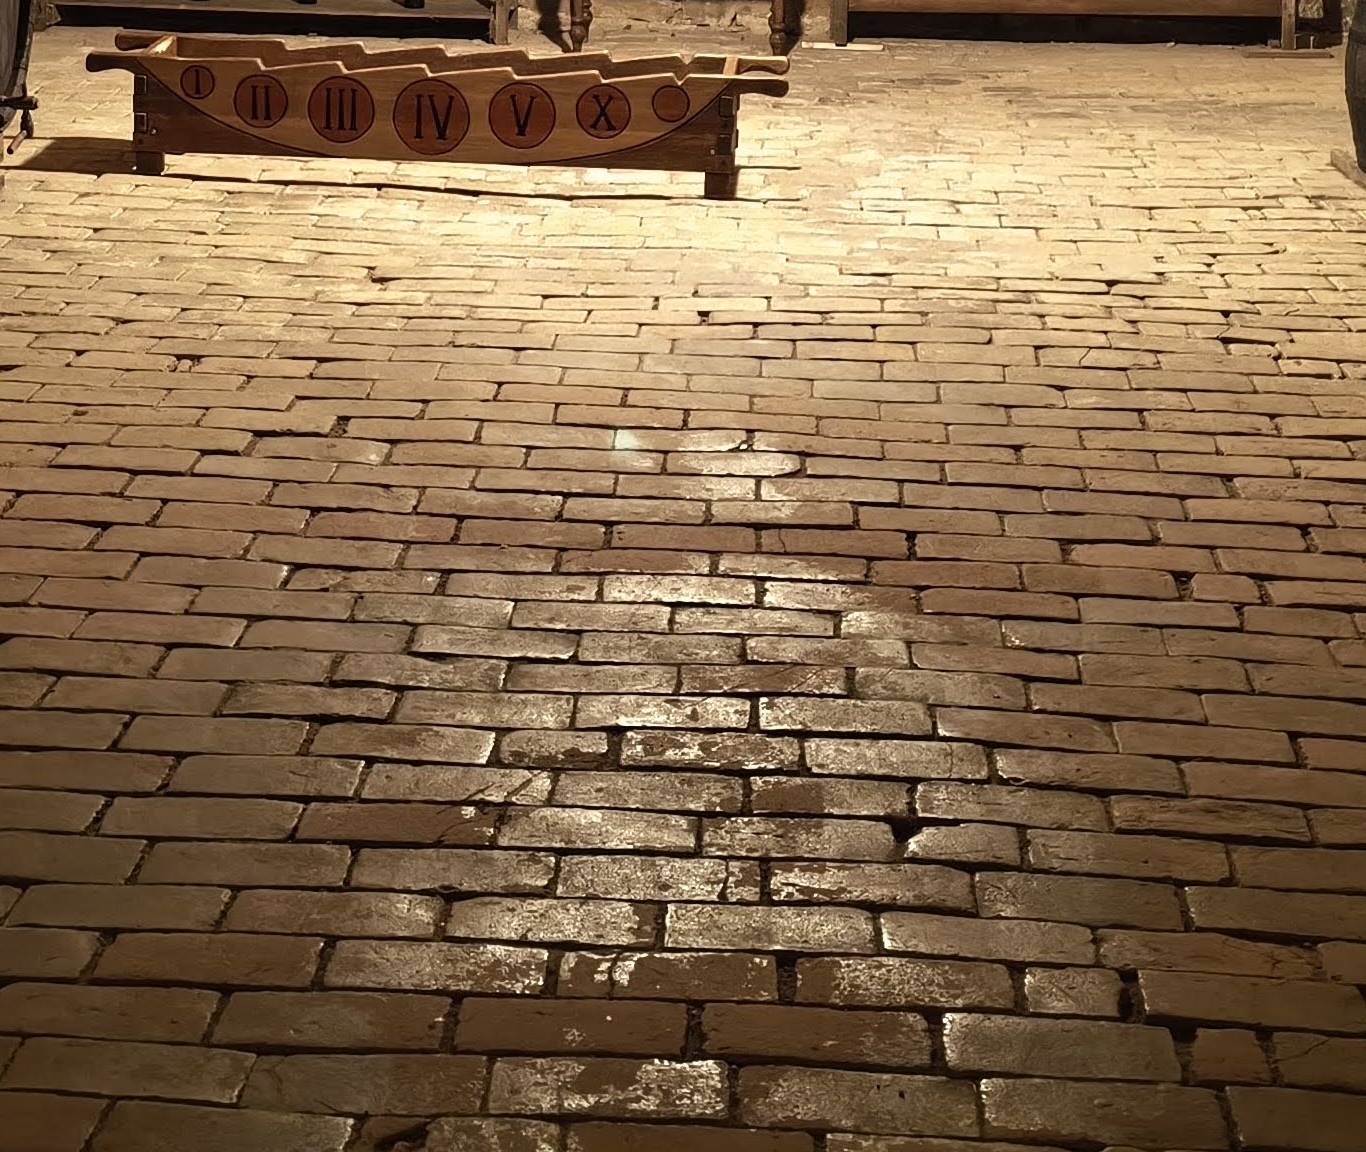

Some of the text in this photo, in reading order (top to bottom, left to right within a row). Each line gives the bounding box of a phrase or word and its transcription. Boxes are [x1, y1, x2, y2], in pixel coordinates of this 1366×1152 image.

[251, 85, 273, 121] II
[323, 87, 358, 132] III
[414, 94, 455, 140] IV
[509, 94, 537, 137] V
[590, 94, 617, 131] X
